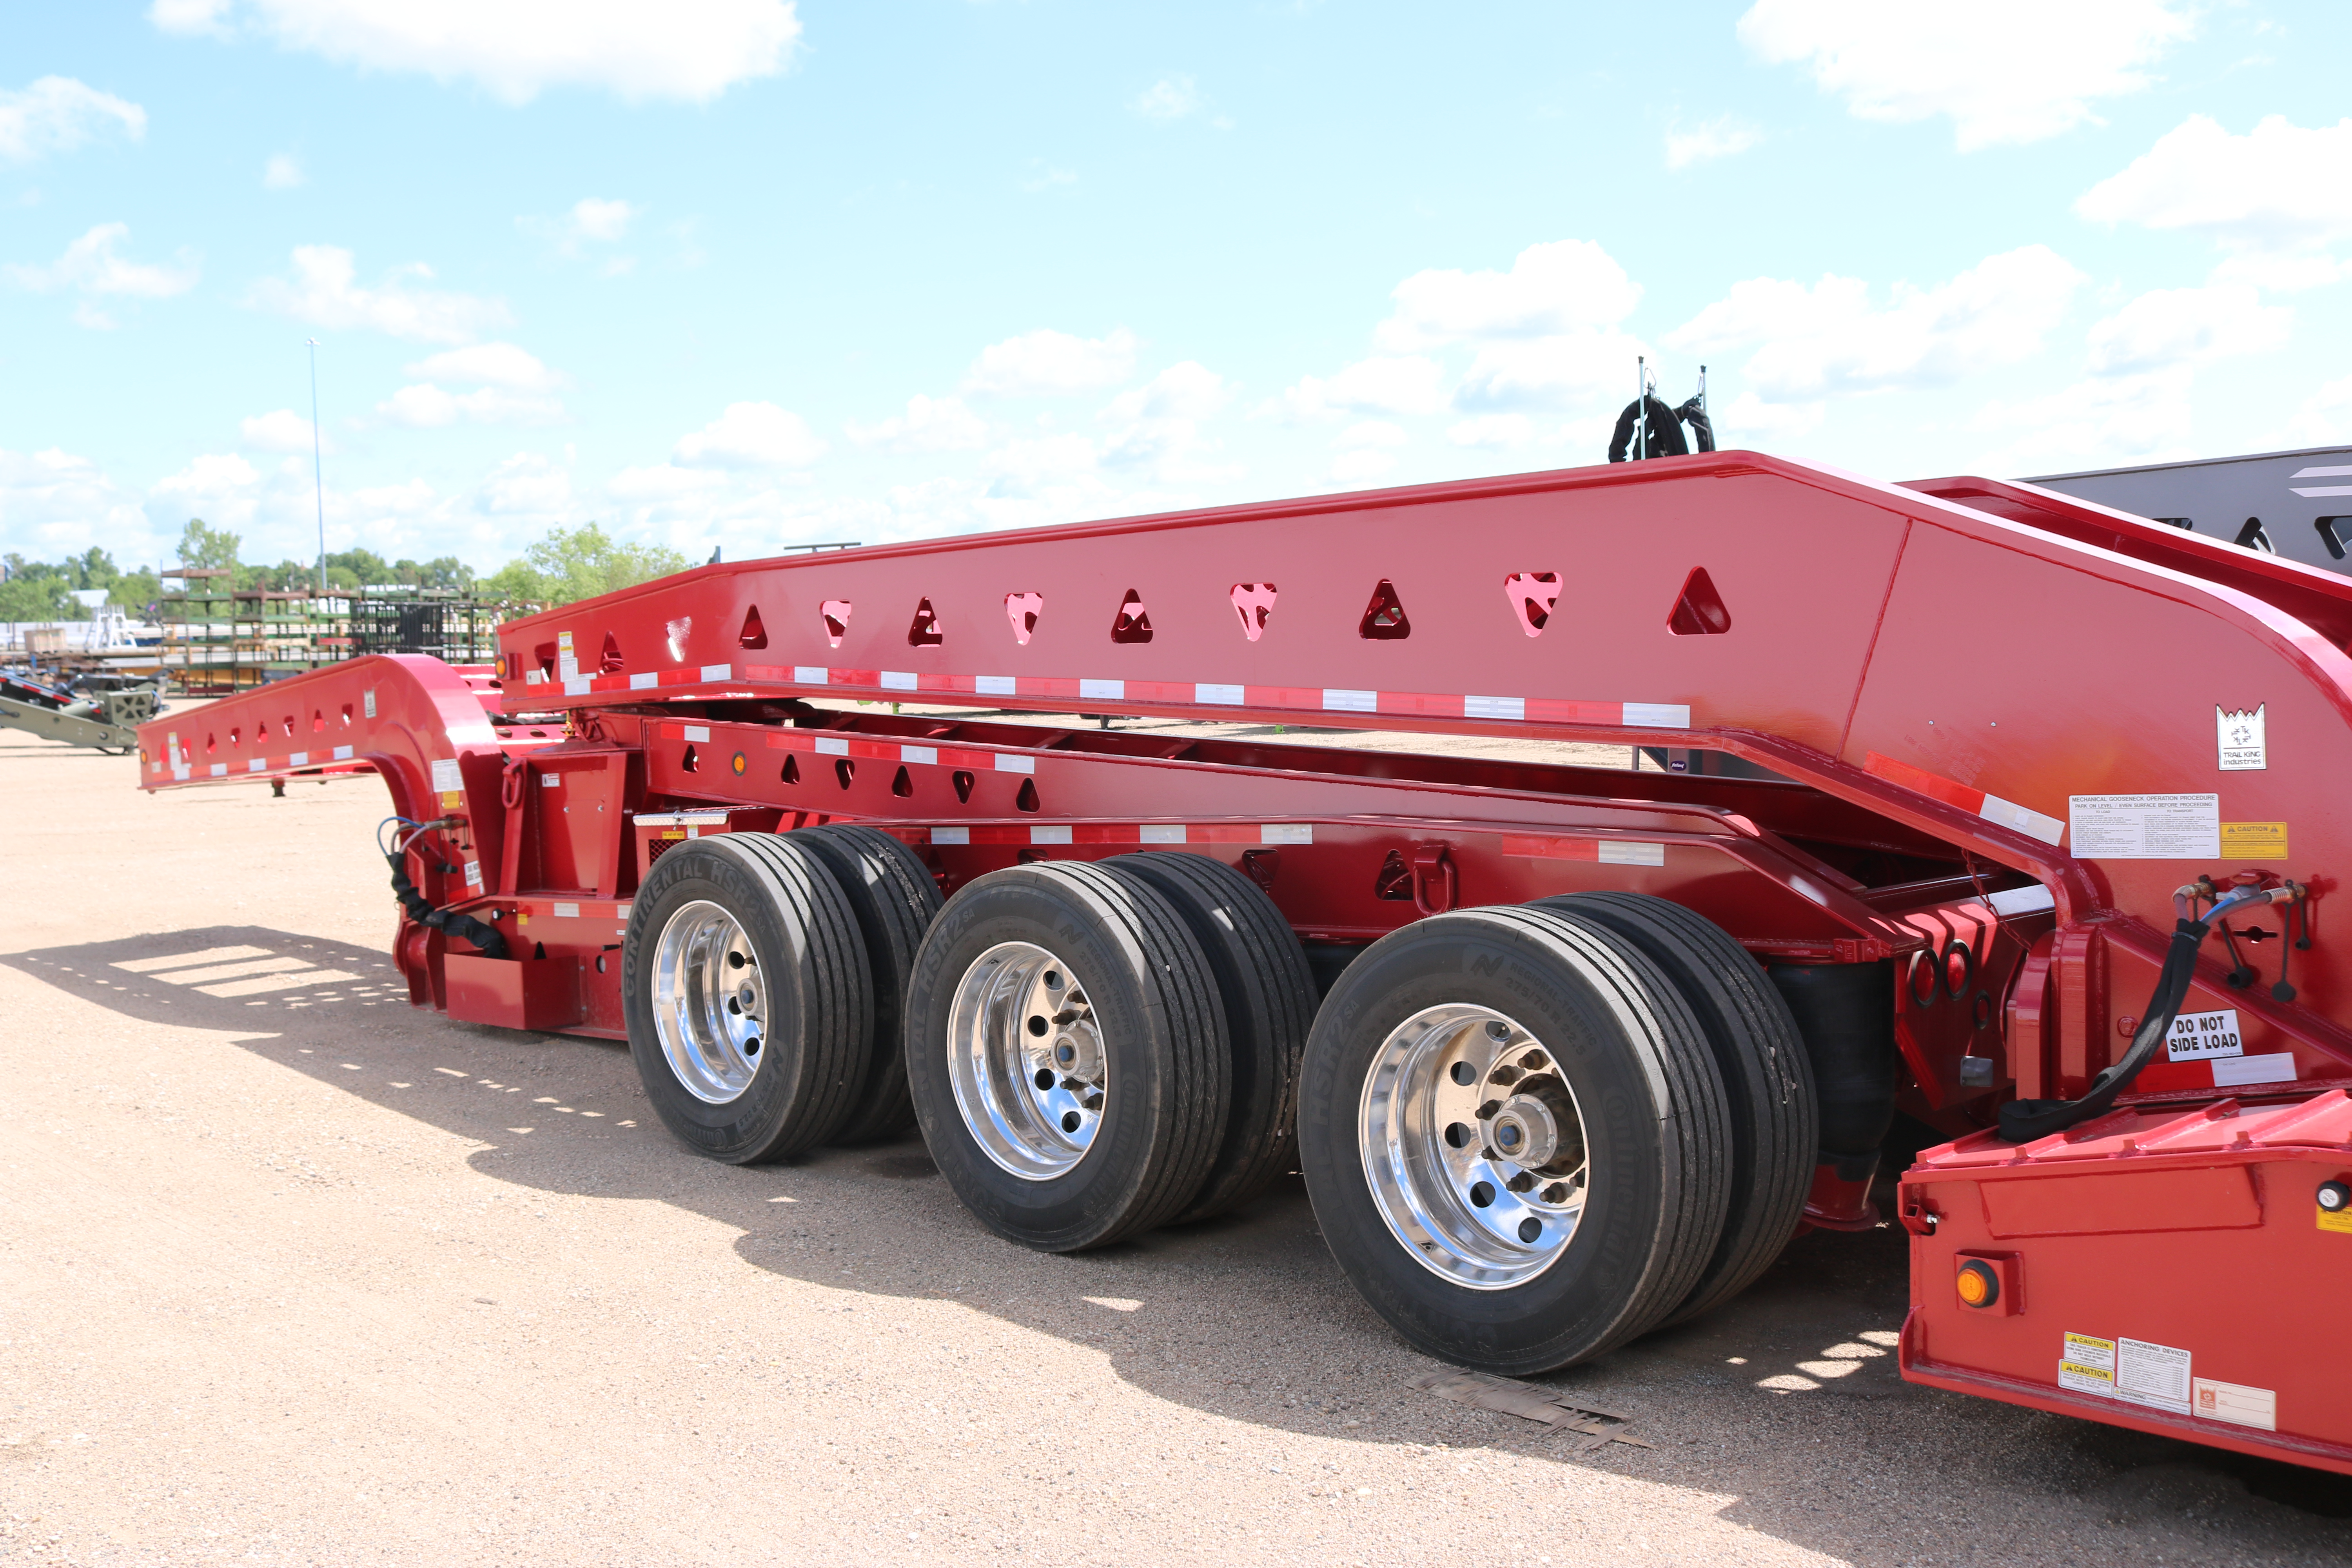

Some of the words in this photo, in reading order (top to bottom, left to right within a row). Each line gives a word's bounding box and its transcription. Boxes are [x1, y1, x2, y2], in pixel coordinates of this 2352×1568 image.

[626, 856, 702, 997] CONTINENTAL
[710, 860, 760, 921] HSR2
[919, 913, 965, 995] HSR2
[1079, 951, 1106, 993] 275/70
[1103, 995, 1112, 1005] R
[1108, 1008, 1122, 1038] 22.5
[1086, 942, 1132, 1035] REGIONAL-TRAFFIC
[1504, 976, 1550, 1013] 275/70
[1550, 1011, 1561, 1024] R
[1560, 1023, 1586, 1056] 22.5
[1510, 962, 1598, 1046] REGIONAL-TRAFFIC
[2176, 1019, 2194, 1034] DO
[2199, 1016, 2224, 1031] NOT
[1310, 1014, 1348, 1127] HSR2
[2169, 1037, 2199, 1052] SIDE
[2203, 1033, 2238, 1049] LOAD
[2074, 1366, 2108, 1378] CAUTION
[2078, 1338, 2109, 1348] CAUTION
[2120, 1339, 2159, 1351] ANCHORING
[2162, 1348, 2188, 1357] DEVICES
[2120, 1390, 2147, 1399] WARNING
